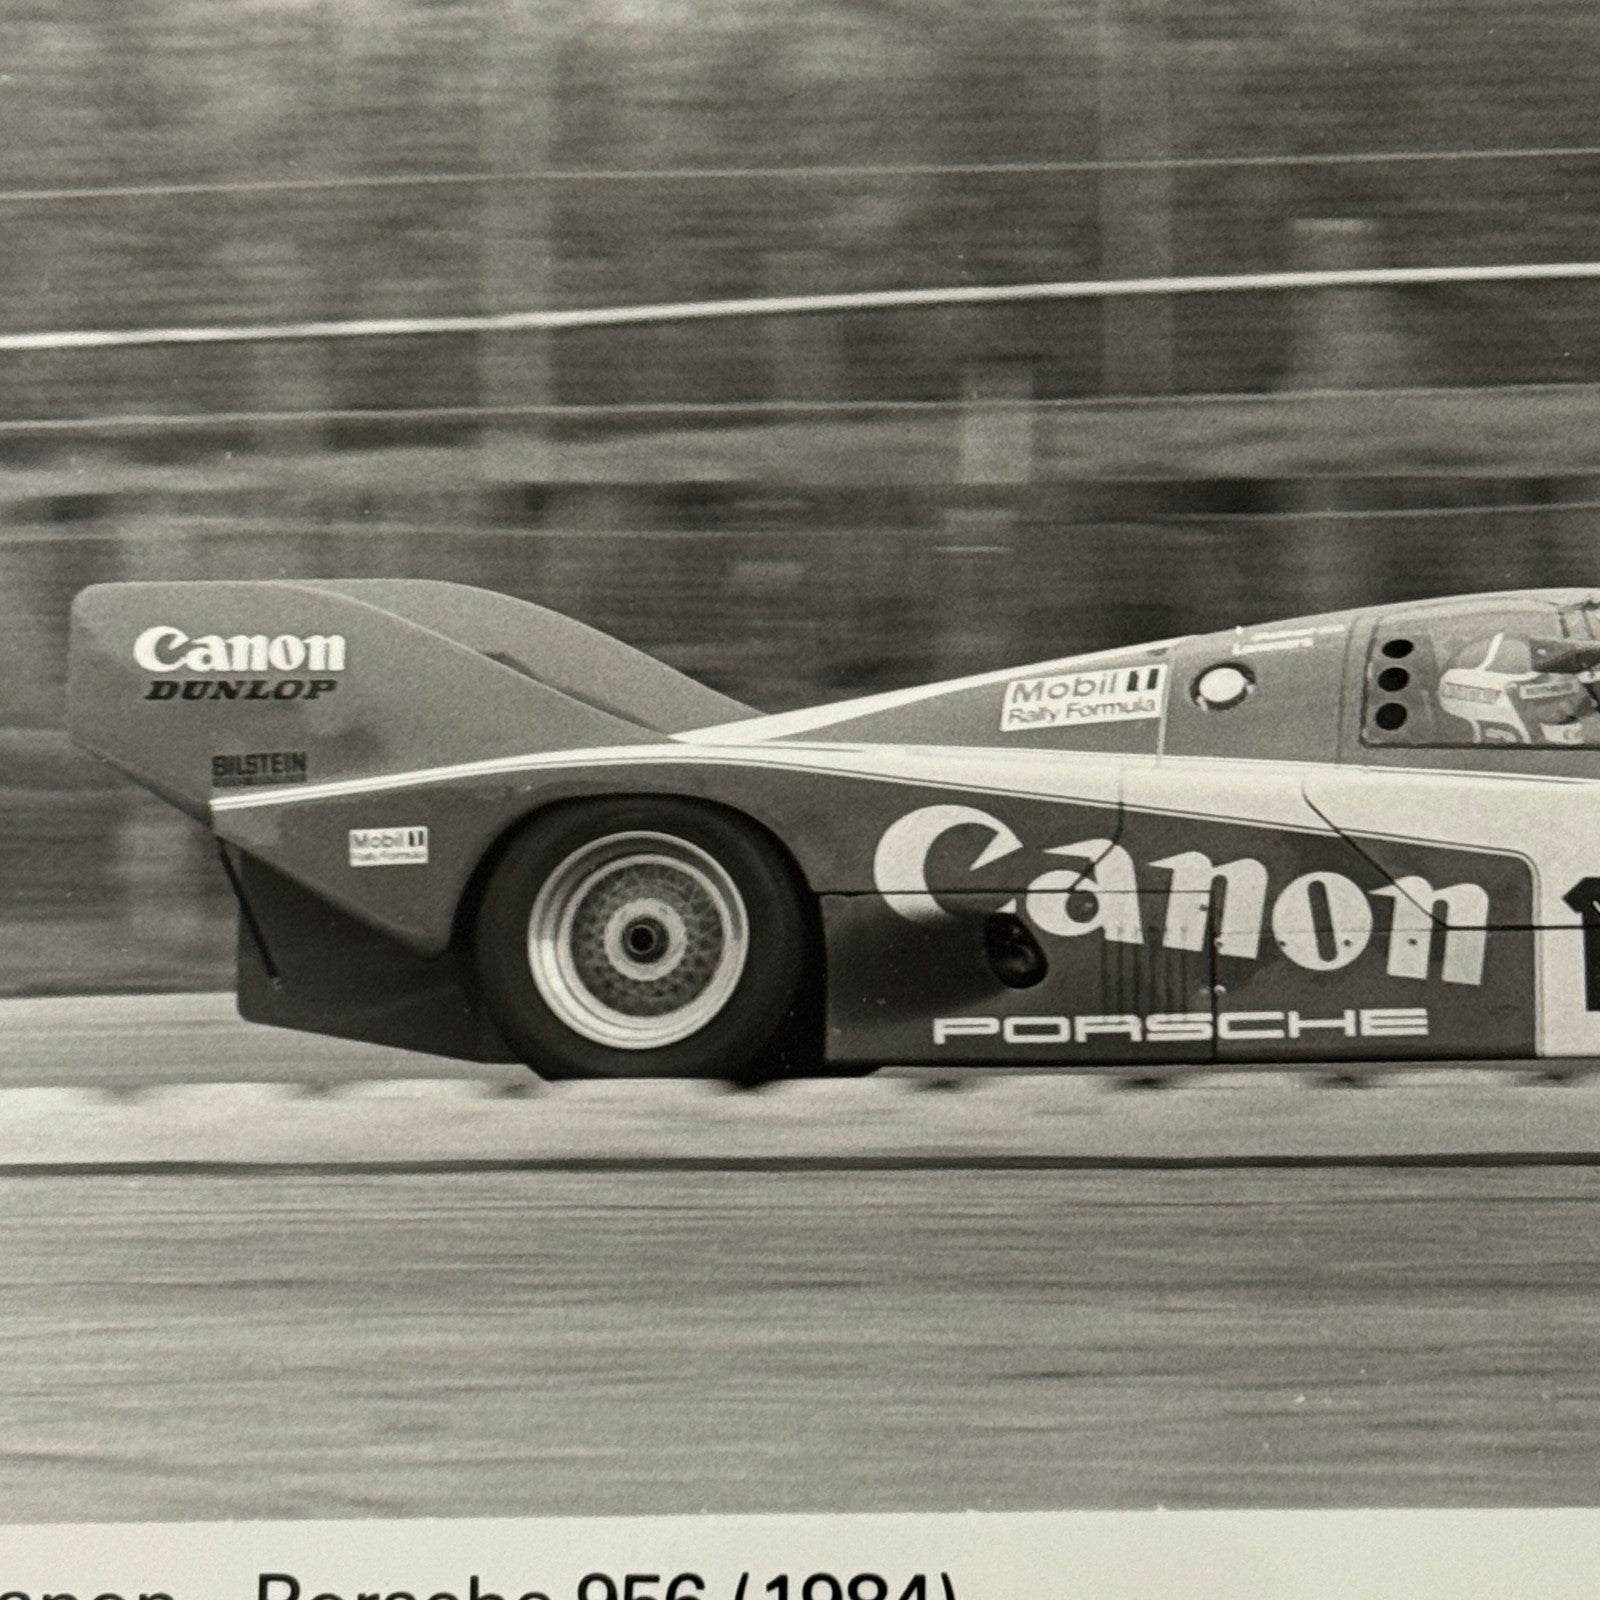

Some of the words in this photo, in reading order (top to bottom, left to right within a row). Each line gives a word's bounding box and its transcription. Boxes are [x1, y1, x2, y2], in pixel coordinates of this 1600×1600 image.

[133, 625, 346, 673] Canon
[144, 679, 338, 701] DUNLOP
[1013, 673, 1118, 704] Mobil
[1007, 706, 1060, 724] Rally
[1065, 698, 1156, 719] Formula
[212, 752, 307, 776] BILSTEIN
[874, 804, 1488, 985] Canon
[933, 1008, 1428, 1045] PORSCHE
